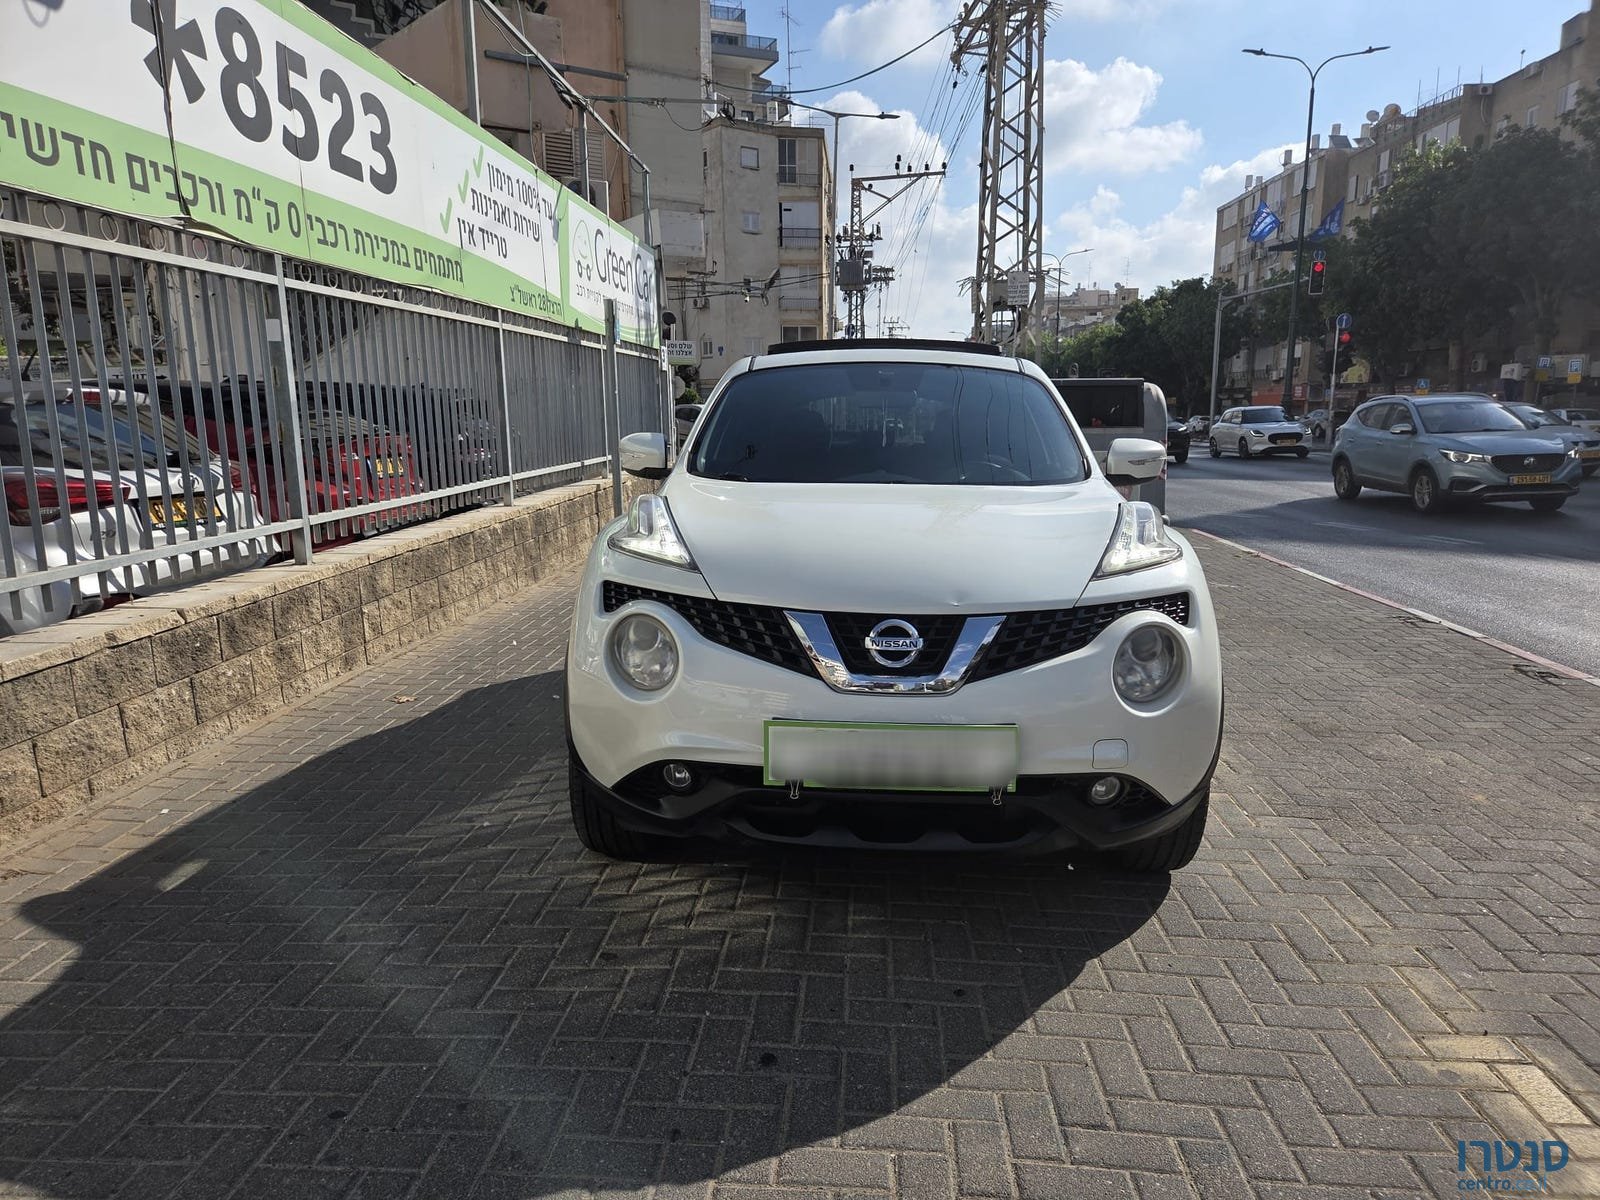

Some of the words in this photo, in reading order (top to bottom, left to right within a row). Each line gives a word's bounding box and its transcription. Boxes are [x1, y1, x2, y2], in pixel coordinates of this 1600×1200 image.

[0, 110, 115, 184] חדשי
[125, 151, 226, 216] ורכבים
[487, 162, 514, 198] מימון
[516, 178, 540, 213] 100%
[470, 187, 512, 229] ואמינות
[513, 210, 540, 242] שירות
[542, 197, 553, 220] עד
[306, 213, 350, 251] רכבי
[353, 228, 411, 268] במכירת
[457, 217, 477, 250] אין
[479, 227, 508, 259] טרייד
[413, 247, 463, 283] מתמחים
[871, 640, 918, 648] NISSAN
